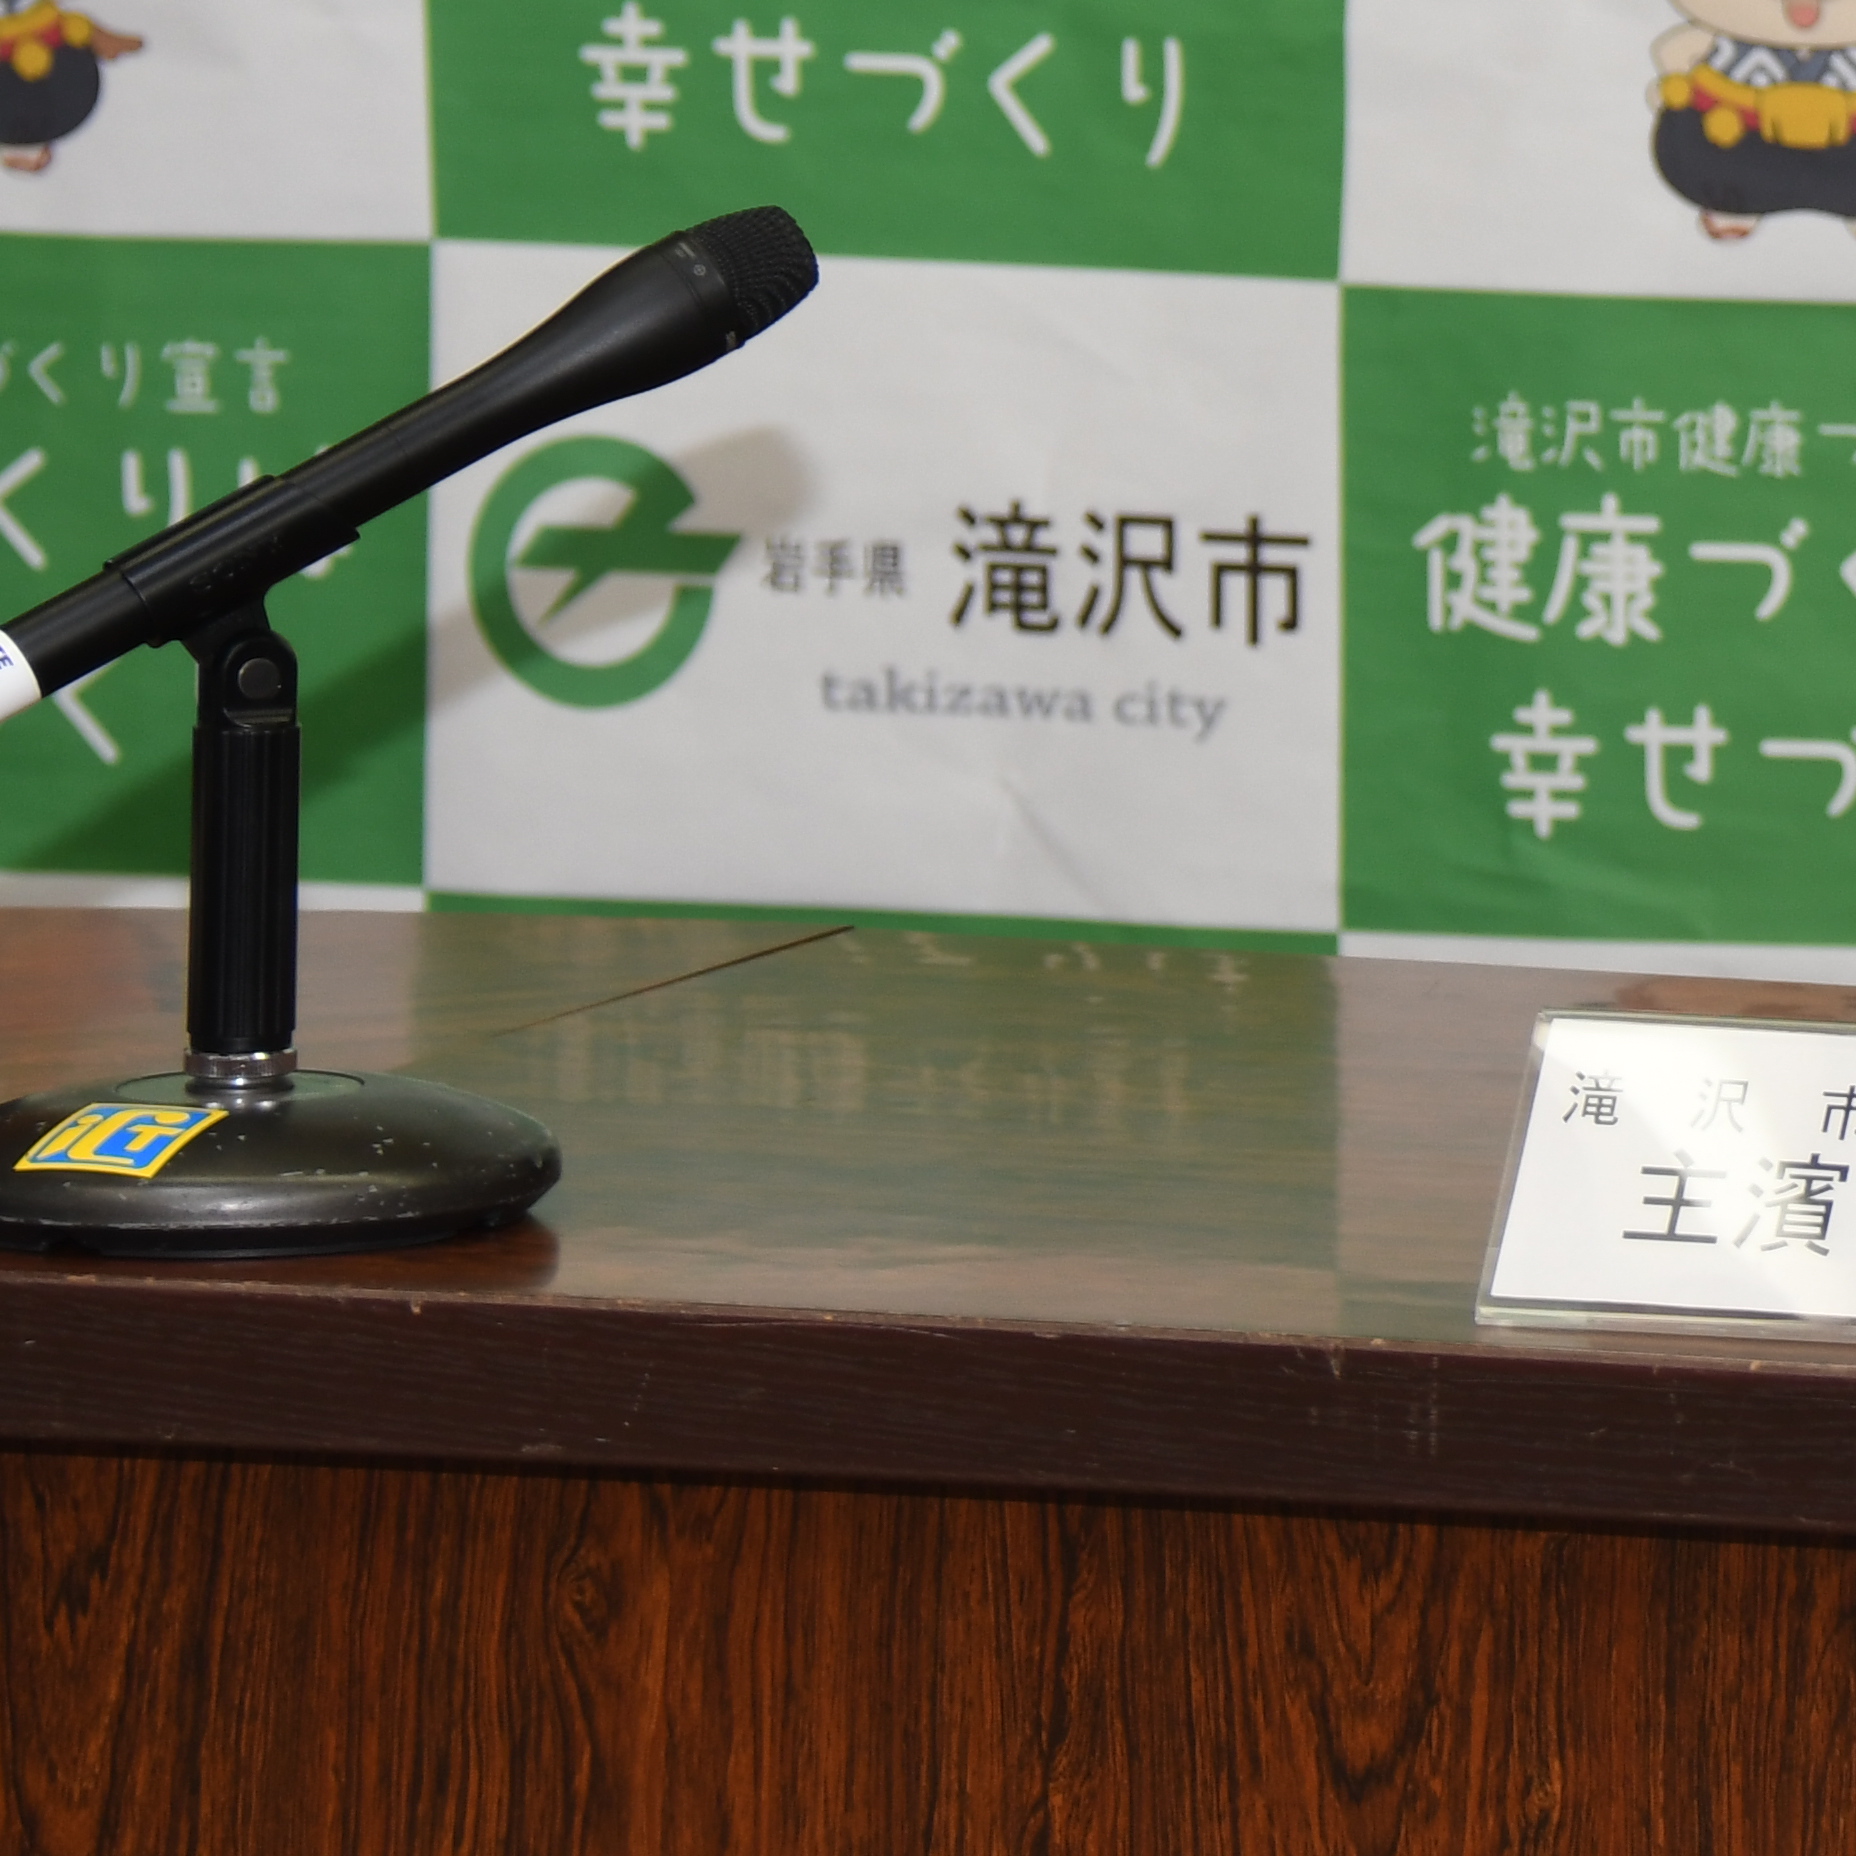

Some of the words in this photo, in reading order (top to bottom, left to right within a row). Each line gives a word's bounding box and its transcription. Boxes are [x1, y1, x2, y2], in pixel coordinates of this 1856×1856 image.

[579, 0, 1186, 169] 幸せづくり
[0, 336, 290, 416] くり宣言
[760, 531, 910, 600] 岩手県
[948, 498, 1313, 649] 滝沢市
[817, 663, 1096, 725] takizawa
[1109, 680, 1229, 744] city
